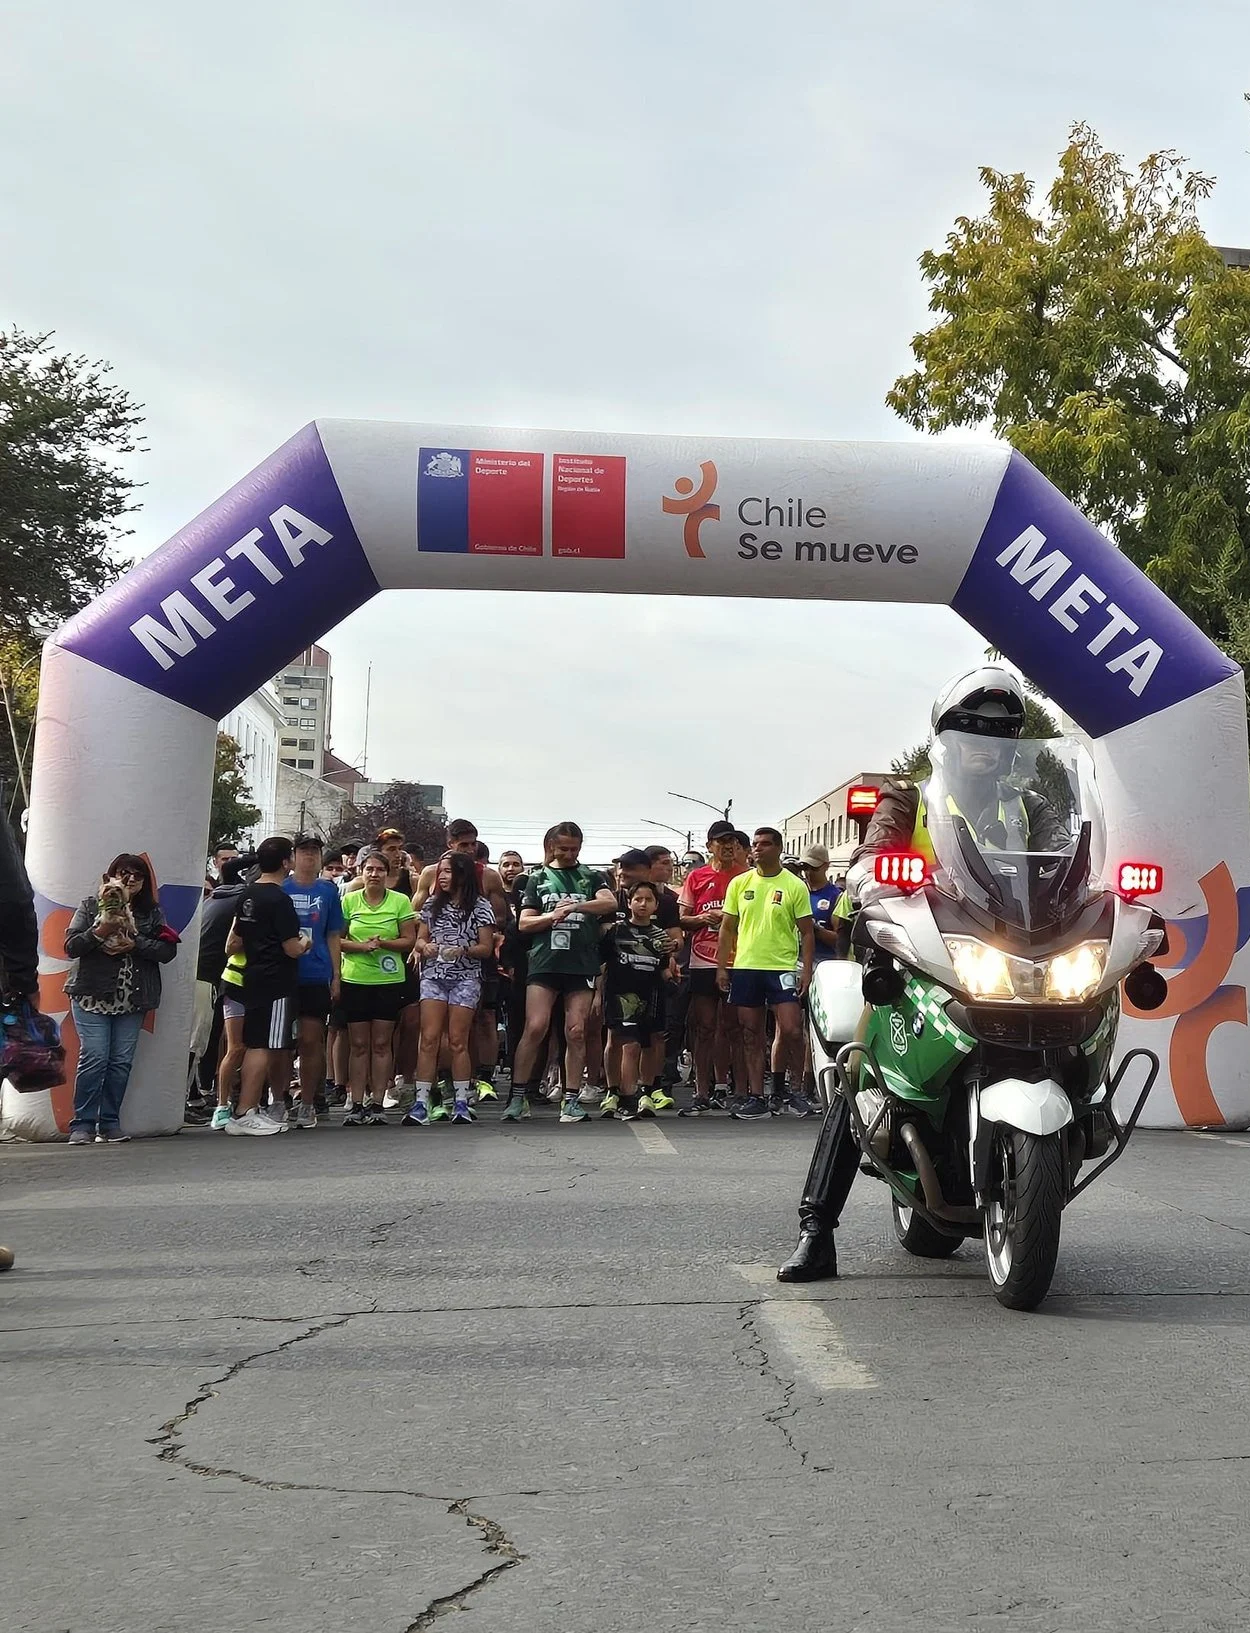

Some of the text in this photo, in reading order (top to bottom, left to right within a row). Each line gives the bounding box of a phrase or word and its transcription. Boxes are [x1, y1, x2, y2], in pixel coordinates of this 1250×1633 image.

[475, 457, 531, 467] Ministerio del
[475, 467, 508, 476] Deporte
[558, 465, 592, 474] Nacional
[558, 475, 594, 484] Deportes
[738, 496, 827, 529] Chile
[518, 545, 537, 553] Chile
[737, 532, 919, 565] Se mueve
[129, 504, 334, 671] META
[995, 524, 1164, 697] META
